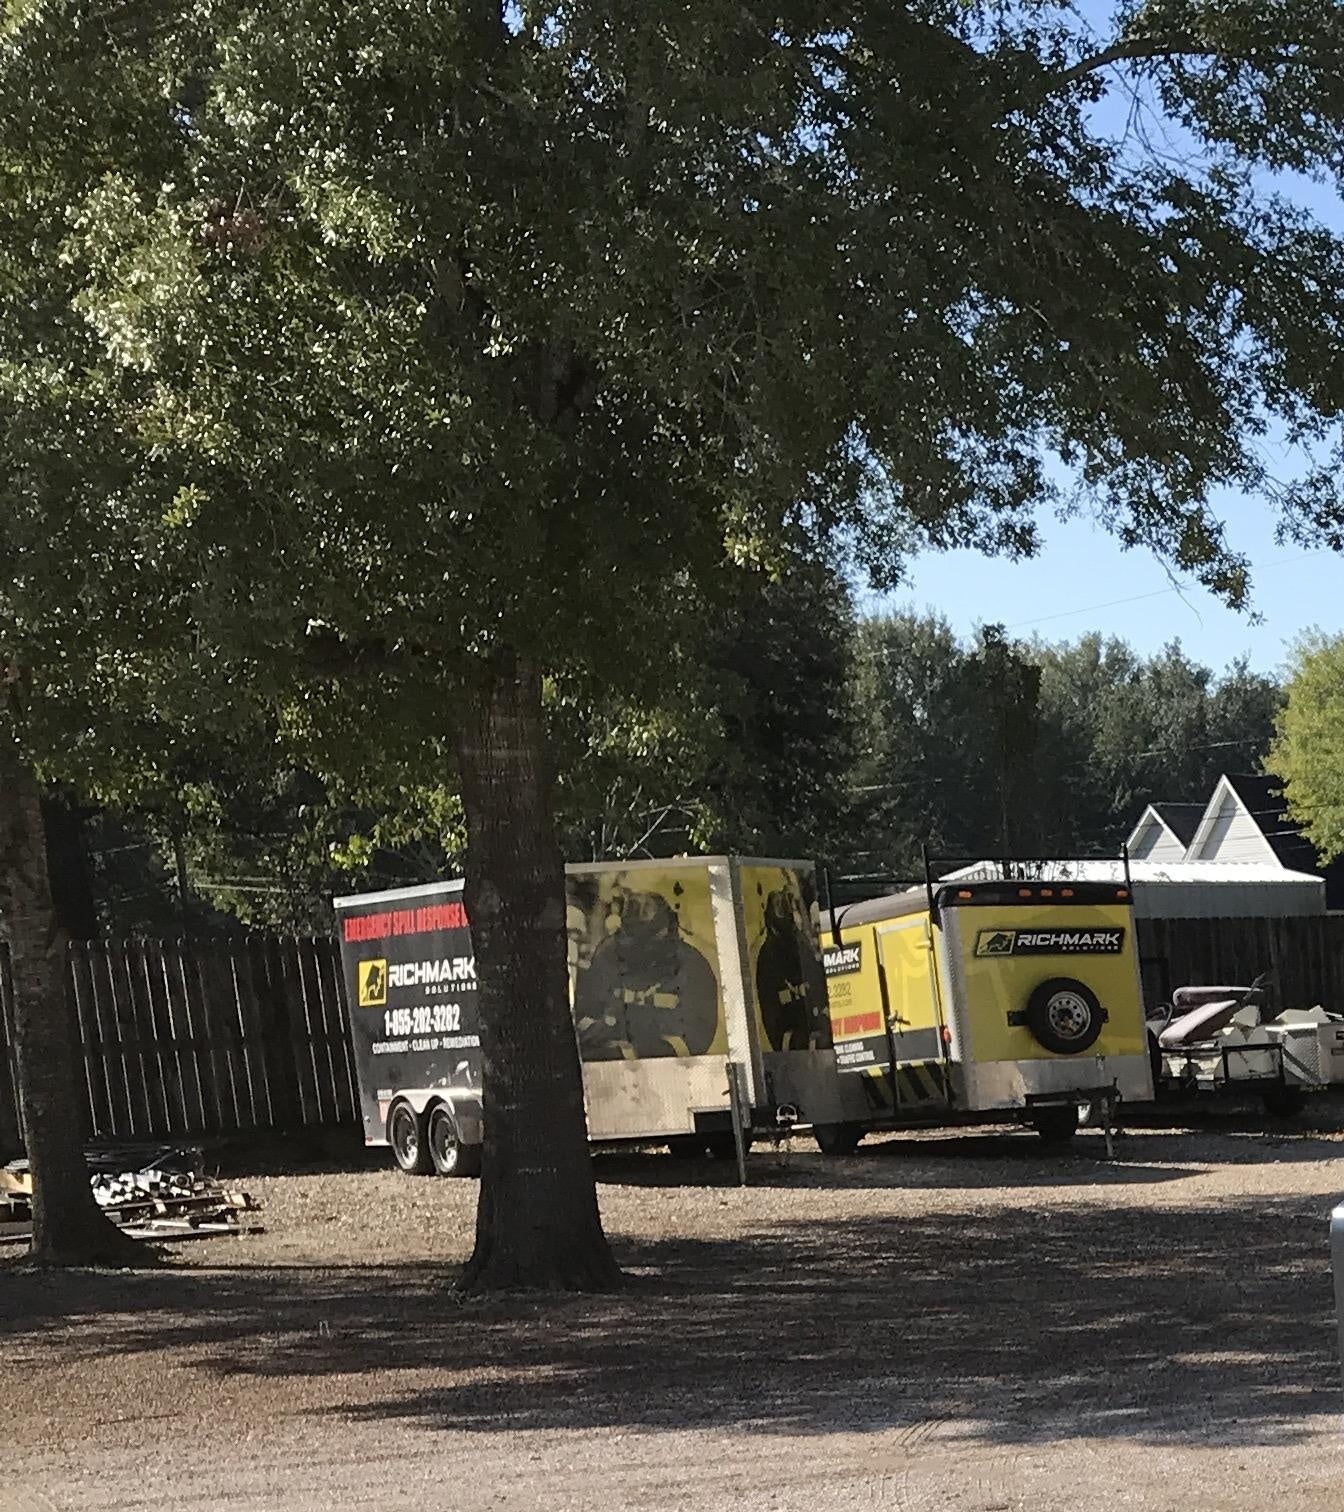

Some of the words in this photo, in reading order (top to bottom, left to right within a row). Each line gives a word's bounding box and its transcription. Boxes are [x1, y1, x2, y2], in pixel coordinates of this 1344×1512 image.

[1017, 933, 1120, 946] RICHMARK
[823, 947, 860, 967] MARK
[388, 956, 477, 988] RICHMARK
[425, 981, 477, 995] SOLUTIONS
[384, 1003, 461, 1037] 1-855-202-3282
